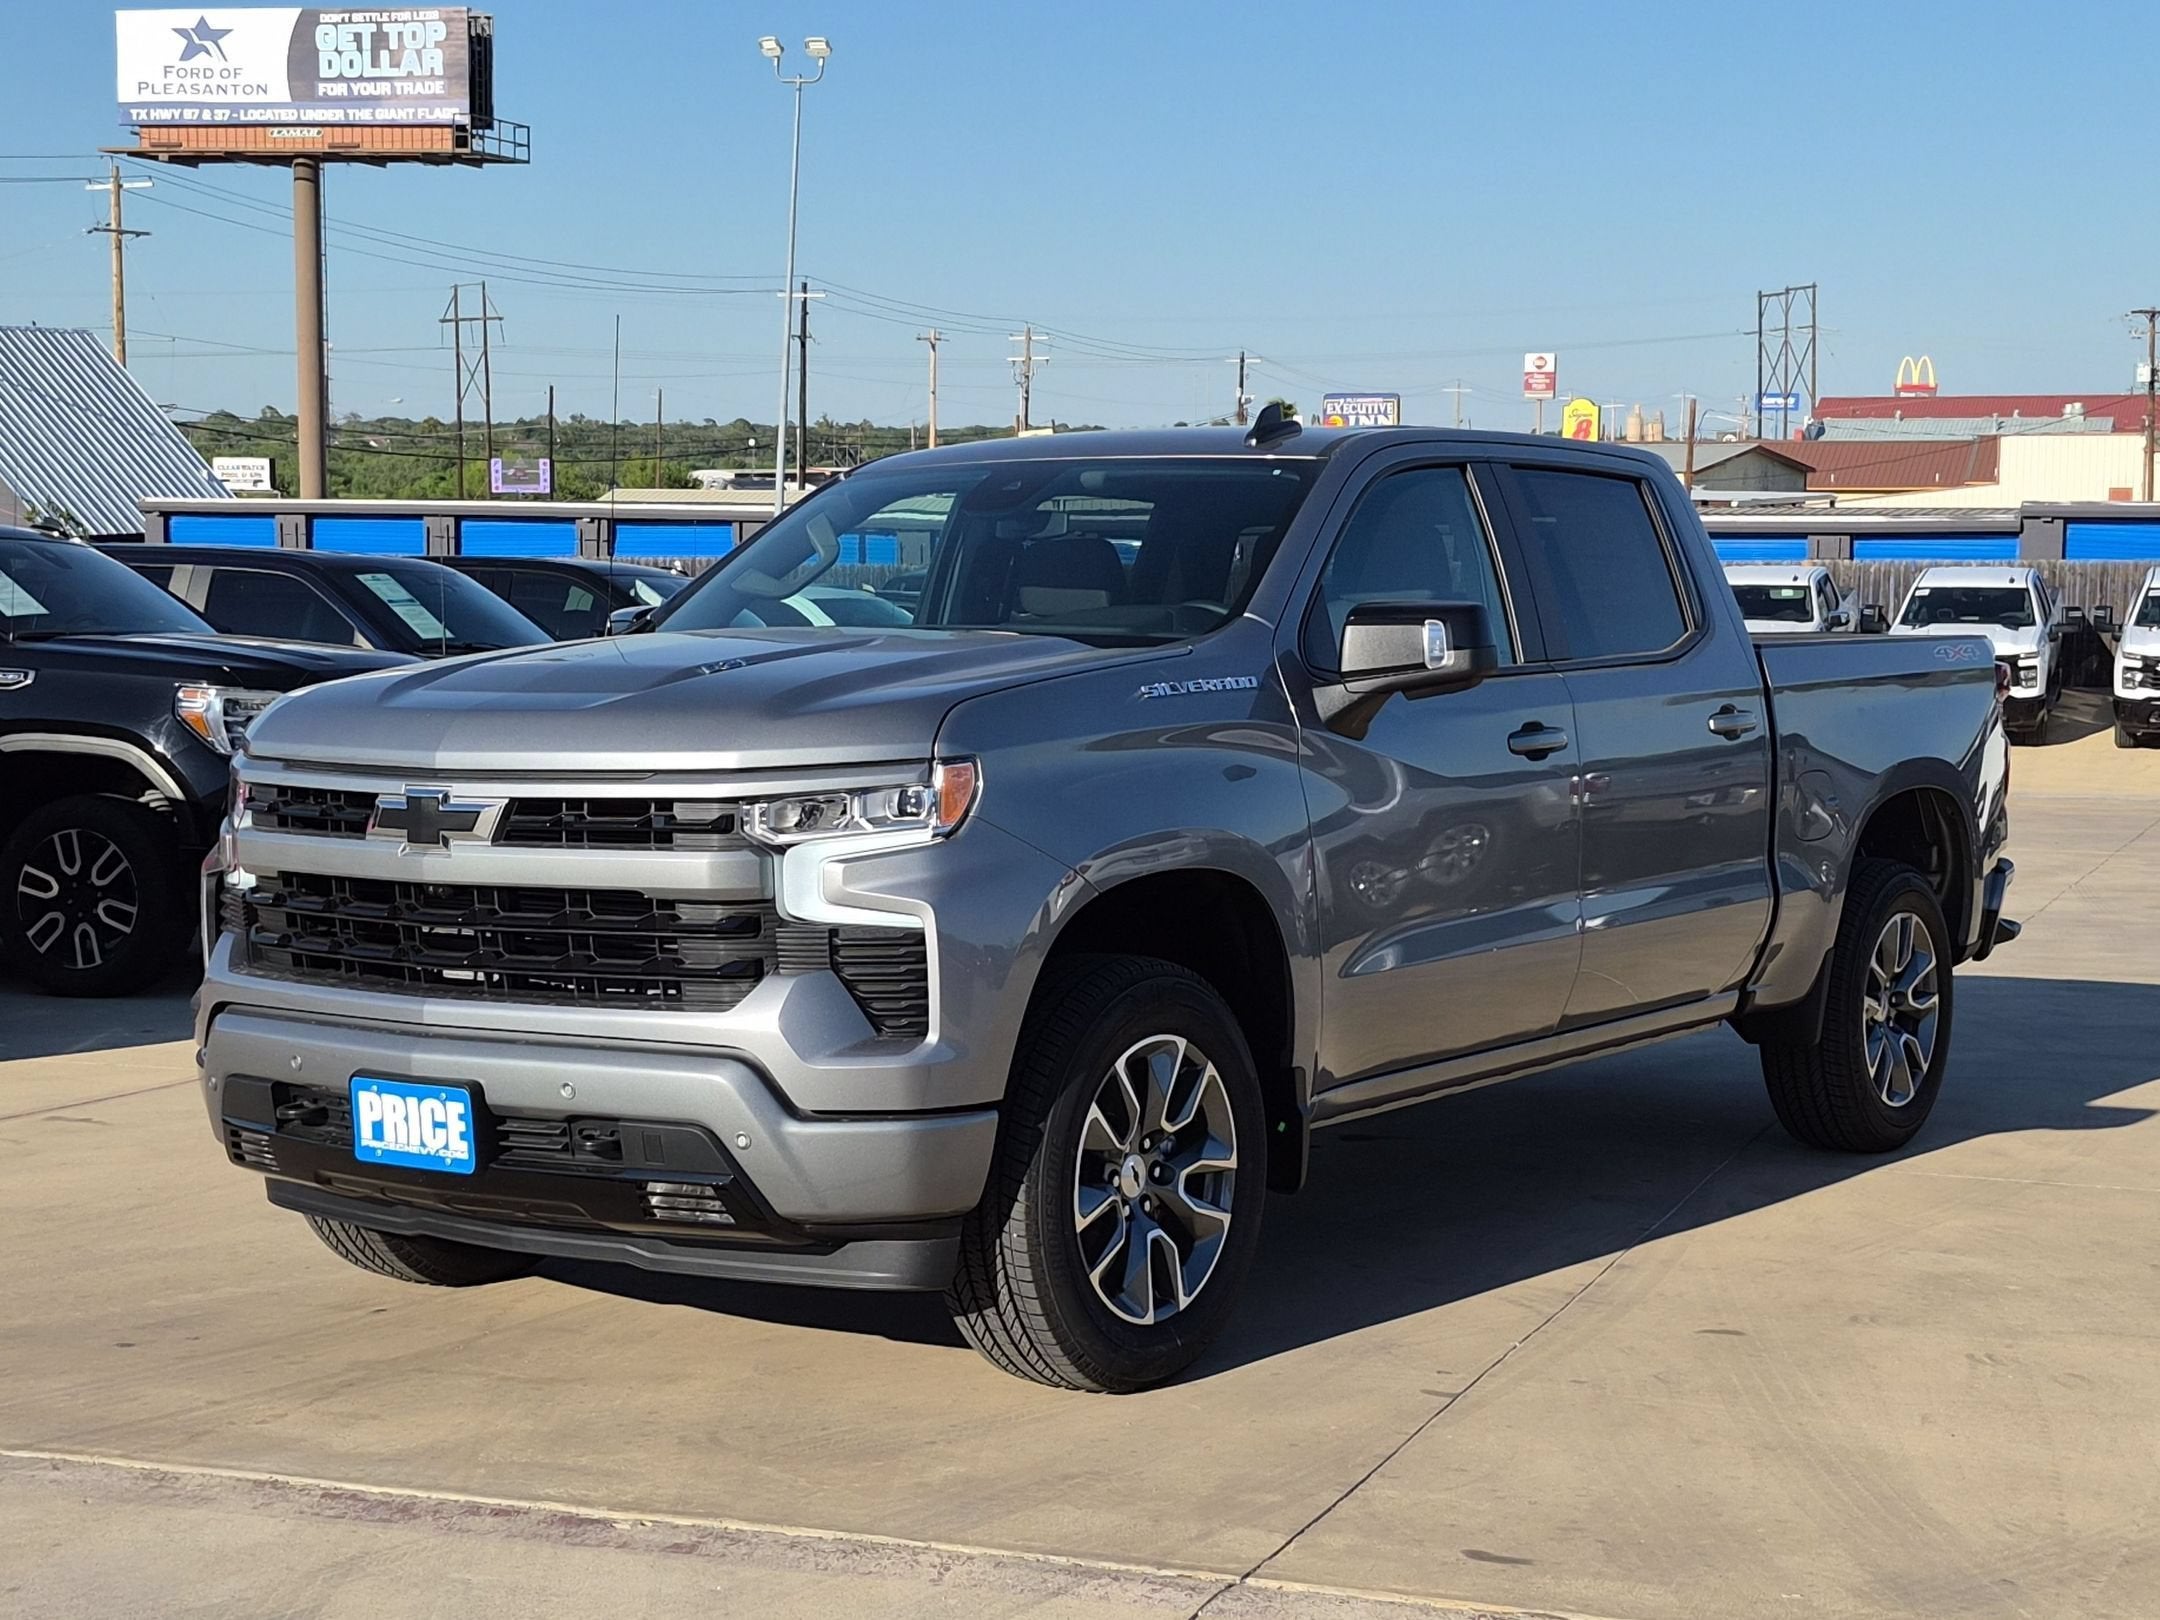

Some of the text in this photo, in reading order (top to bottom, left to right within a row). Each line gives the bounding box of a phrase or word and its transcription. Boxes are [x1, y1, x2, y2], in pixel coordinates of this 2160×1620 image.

[352, 12, 390, 22] SETTLE
[391, 11, 411, 21] FOR
[315, 22, 447, 51] GET TOP
[319, 49, 444, 78] DOLLAR
[163, 66, 243, 79] FORD OF
[138, 82, 268, 95] PLEASANTON
[318, 81, 445, 96] FOR YOUR TRADE
[130, 109, 148, 120] TX
[150, 109, 181, 120] HWY
[202, 109, 212, 120] &
[240, 109, 299, 120] LOCATED
[301, 109, 344, 120] UNDER
[346, 109, 373, 120] THE
[375, 108, 416, 119] GIANT
[1326, 399, 1394, 415] EXECUTIVE
[1348, 415, 1394, 426] INN
[1139, 676, 1258, 698] SILVERADO
[358, 1090, 468, 1153] PRICE
